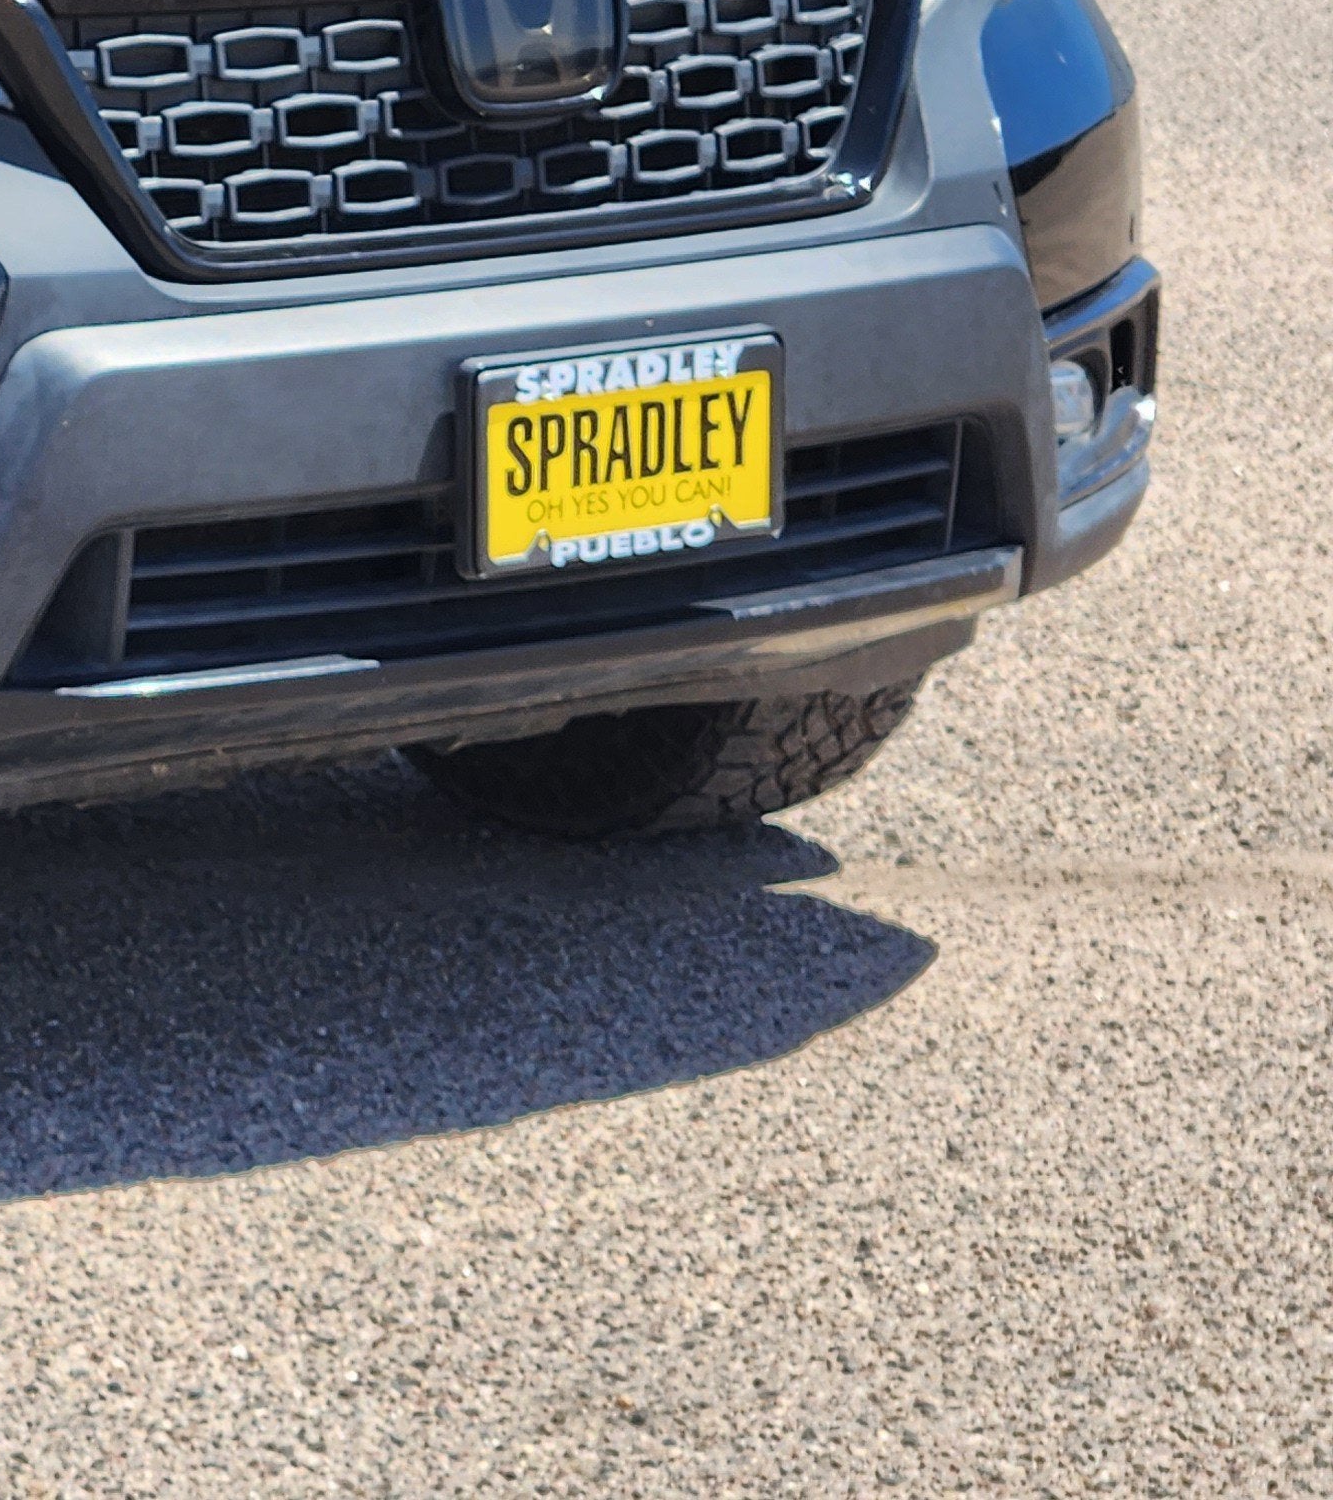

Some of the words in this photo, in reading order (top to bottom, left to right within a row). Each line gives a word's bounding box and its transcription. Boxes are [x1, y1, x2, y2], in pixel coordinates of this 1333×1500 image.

[514, 344, 745, 404] SPRADLEY
[506, 388, 754, 497] SPRADLEY
[527, 499, 564, 523] OH
[572, 491, 609, 516] YES
[617, 485, 666, 510] YOU
[675, 476, 731, 504] CAN!
[551, 520, 715, 567] PUEBLO
